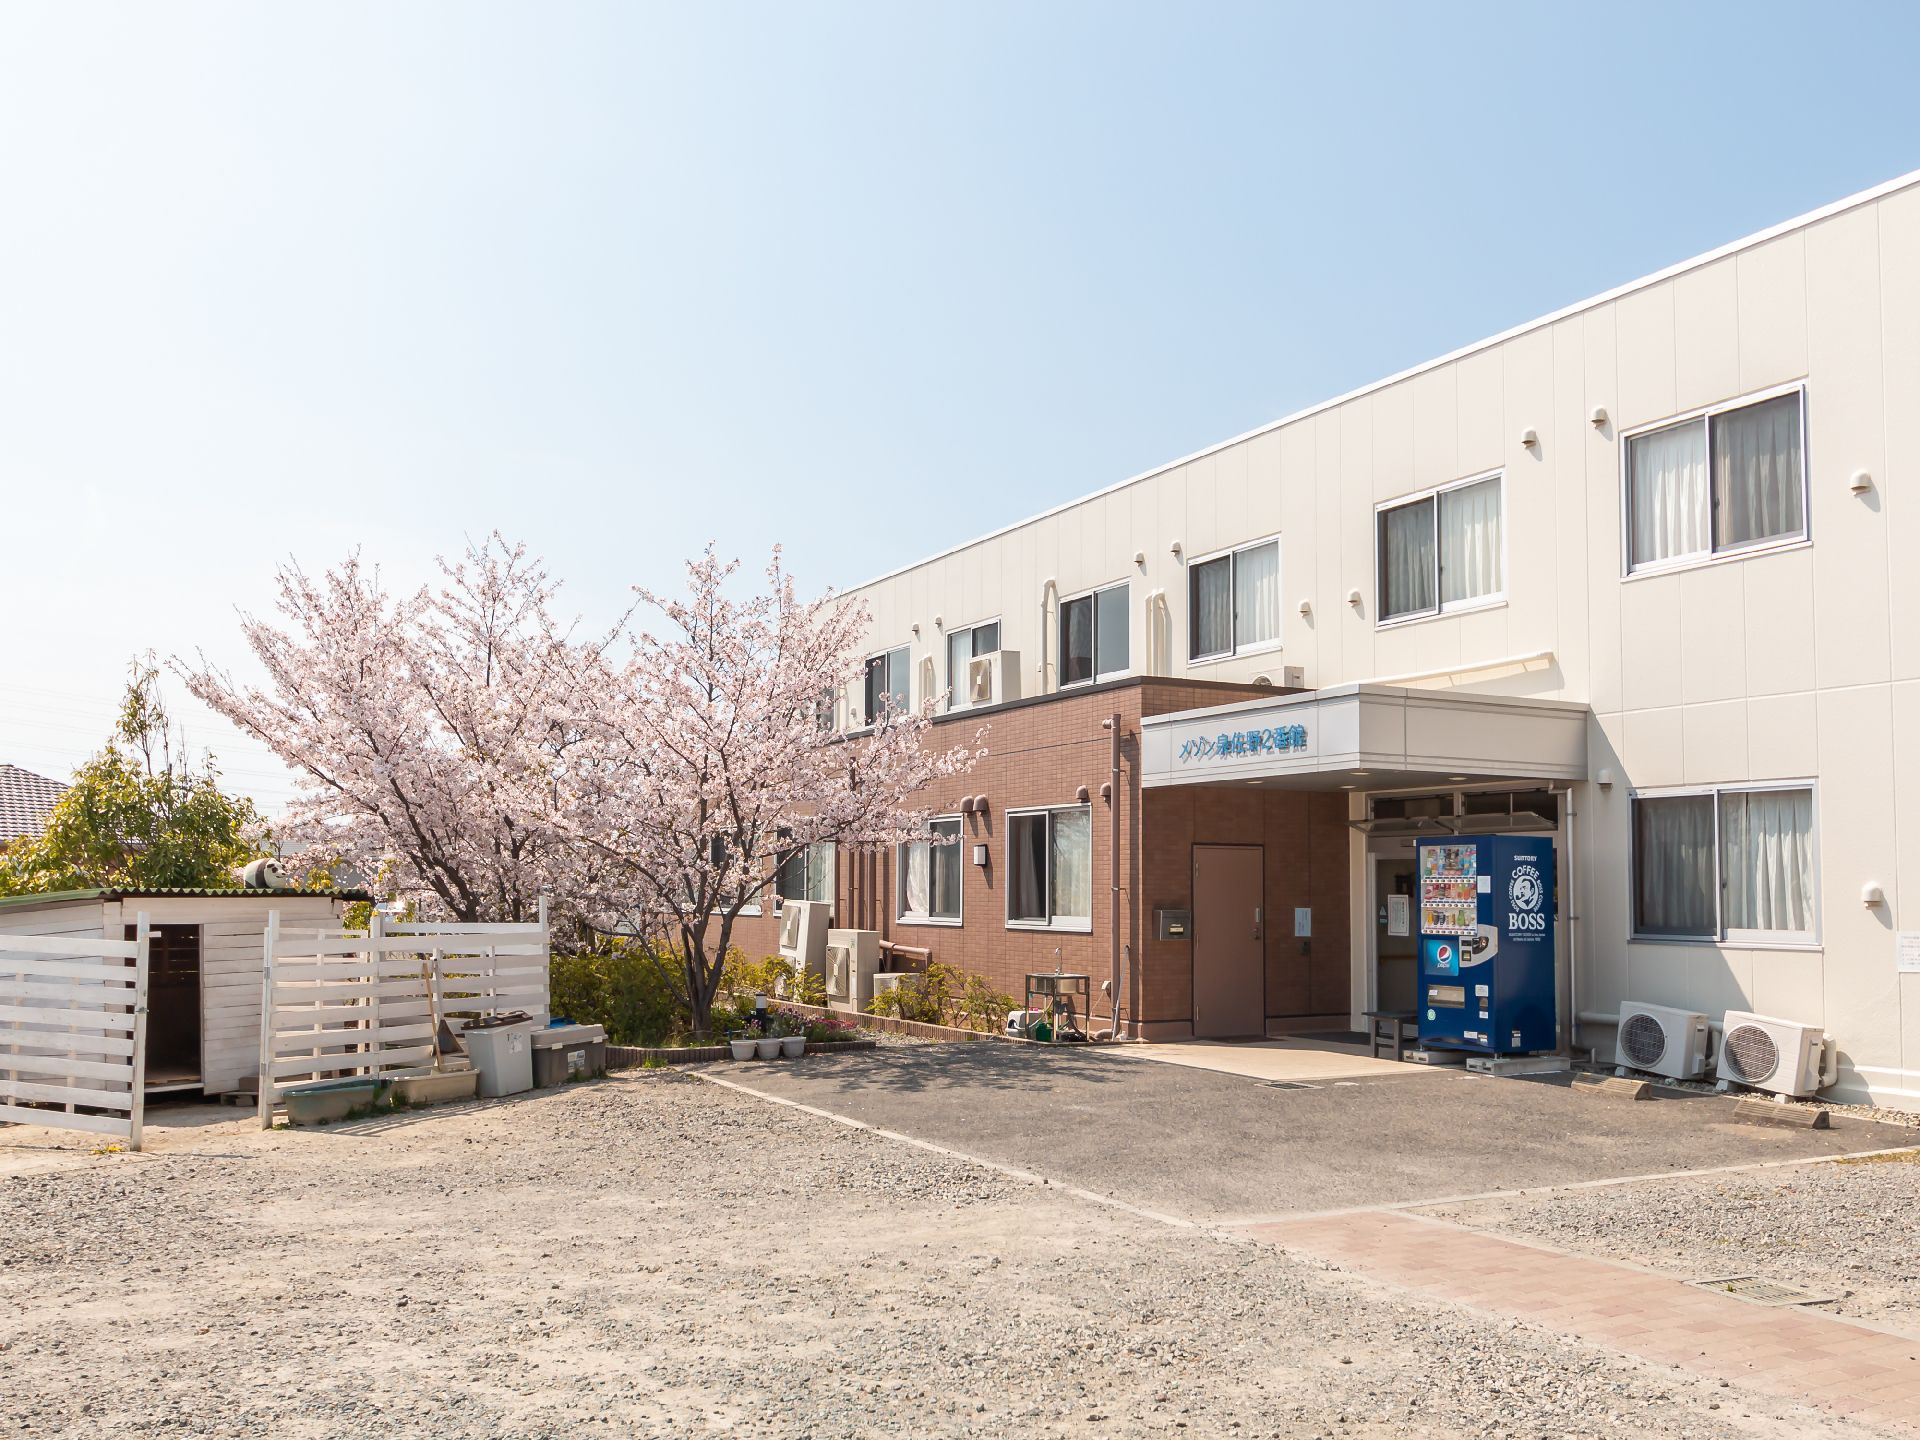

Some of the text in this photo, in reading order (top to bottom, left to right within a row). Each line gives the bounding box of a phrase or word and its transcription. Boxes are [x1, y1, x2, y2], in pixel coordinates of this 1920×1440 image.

[1179, 724, 1305, 758] メゾン泉佐野2番館
[1512, 865, 1539, 879] COFFEE
[1508, 913, 1545, 930] BOSS
